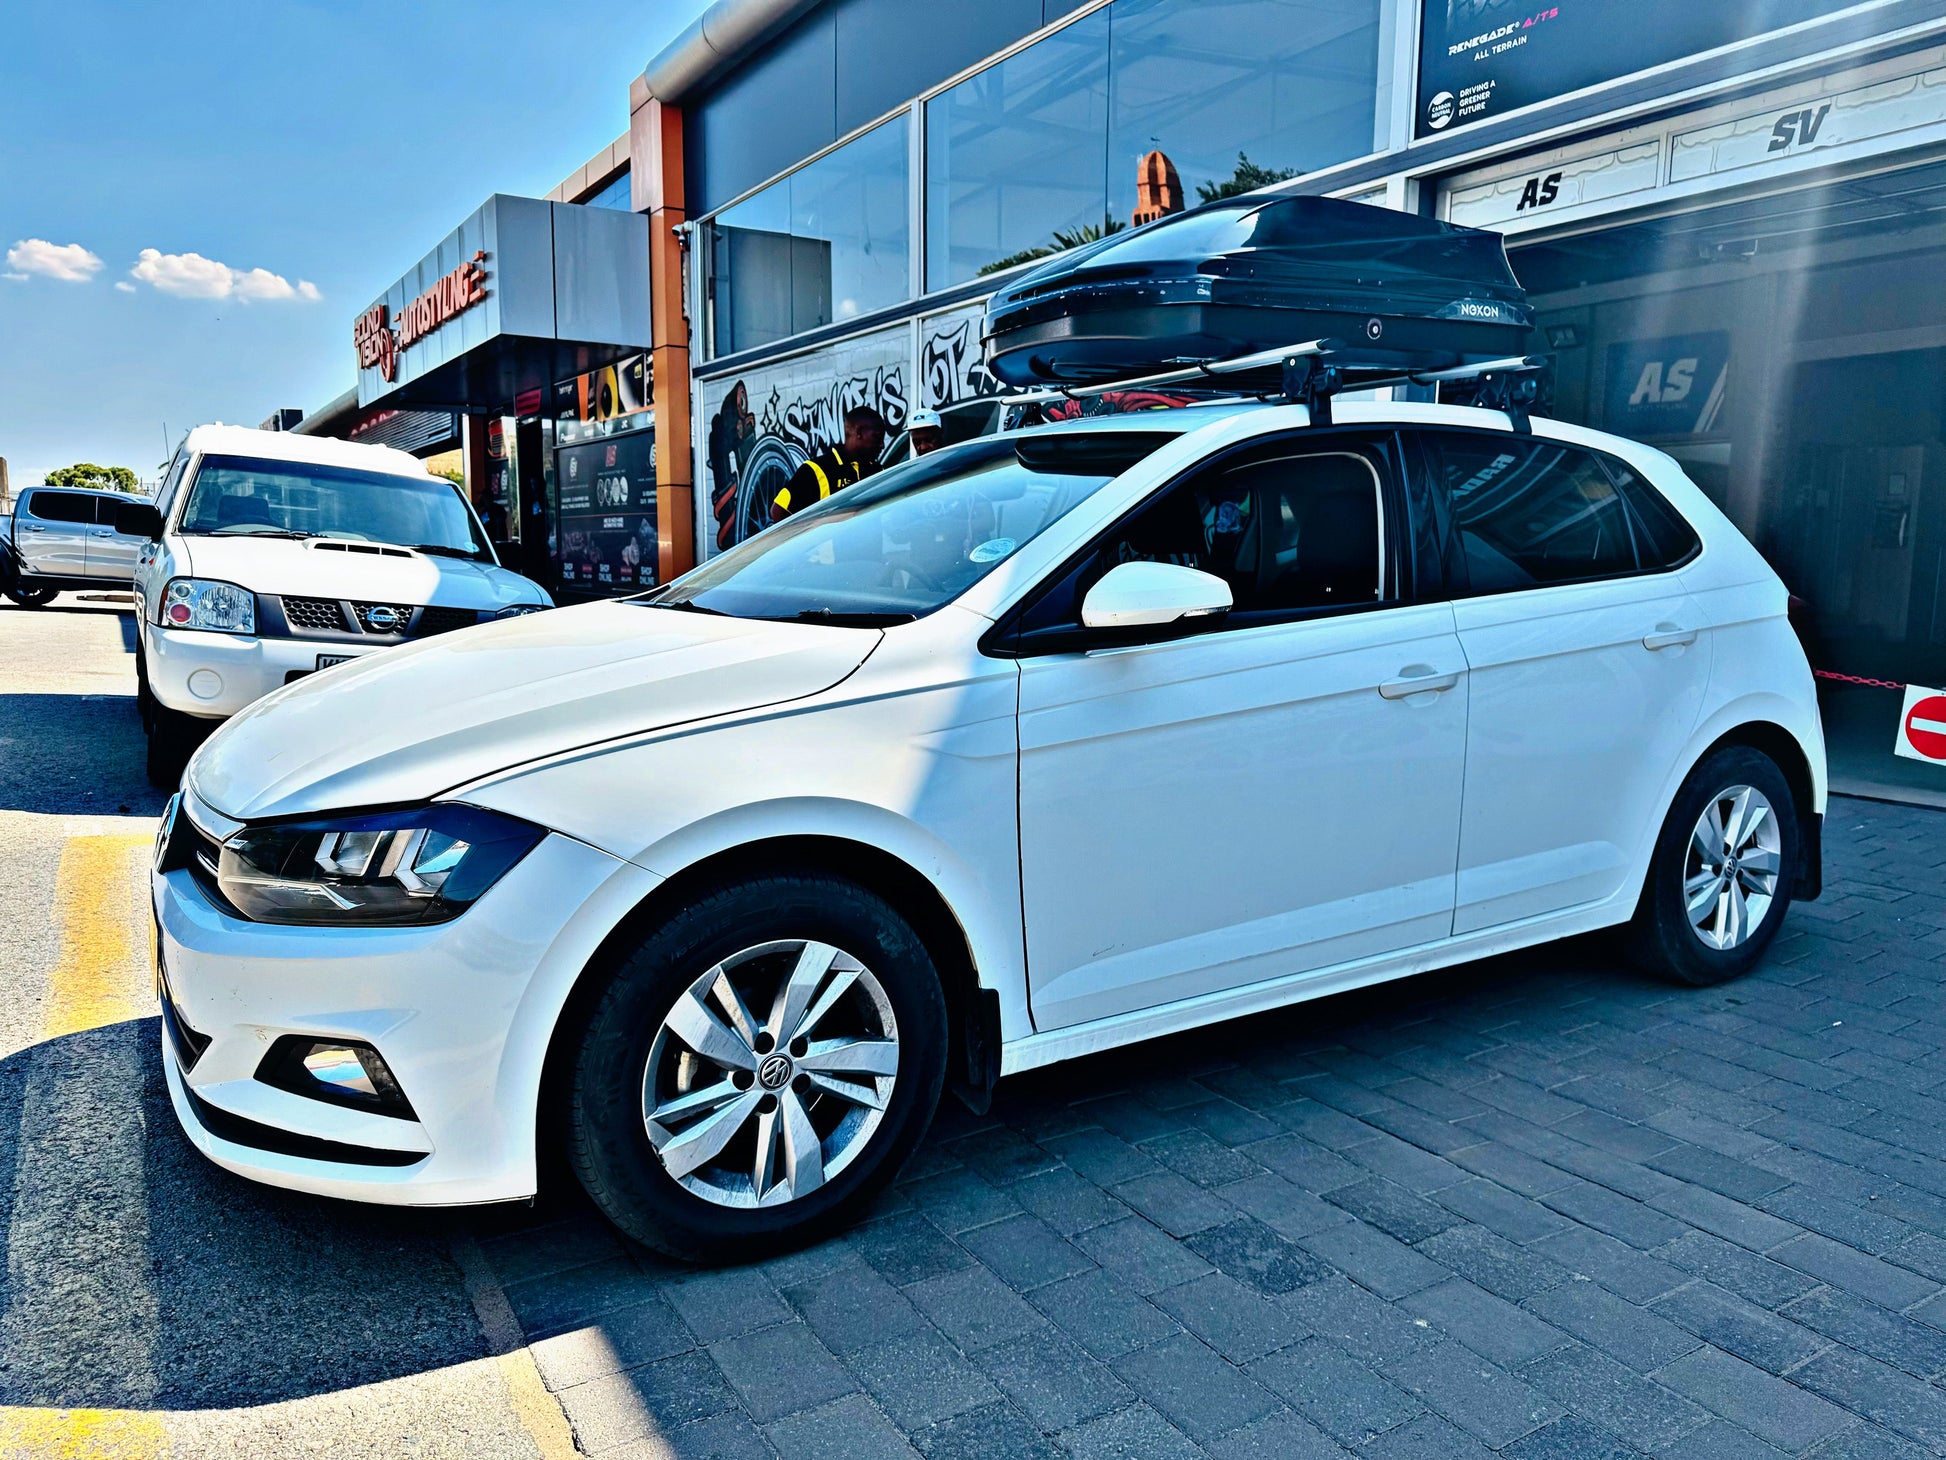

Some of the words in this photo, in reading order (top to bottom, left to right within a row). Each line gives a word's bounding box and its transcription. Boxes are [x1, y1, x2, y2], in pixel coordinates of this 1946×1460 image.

[1474, 51, 1490, 61] ALL
[1491, 35, 1527, 55] TERRAIN
[1459, 81, 1489, 98] DRIVING
[1489, 79, 1496, 88] A
[1459, 90, 1491, 107] GREENER
[1431, 102, 1452, 113] CARBON
[1431, 108, 1451, 119] NEUTRAL
[1458, 101, 1486, 117] FUTURE
[1767, 103, 1832, 152] SV
[1516, 171, 1562, 211] AS
[399, 261, 474, 352] AUTOSTYLING
[1461, 303, 1499, 318] NOXON
[354, 304, 384, 348] SOUND
[1628, 357, 1698, 406] AS
